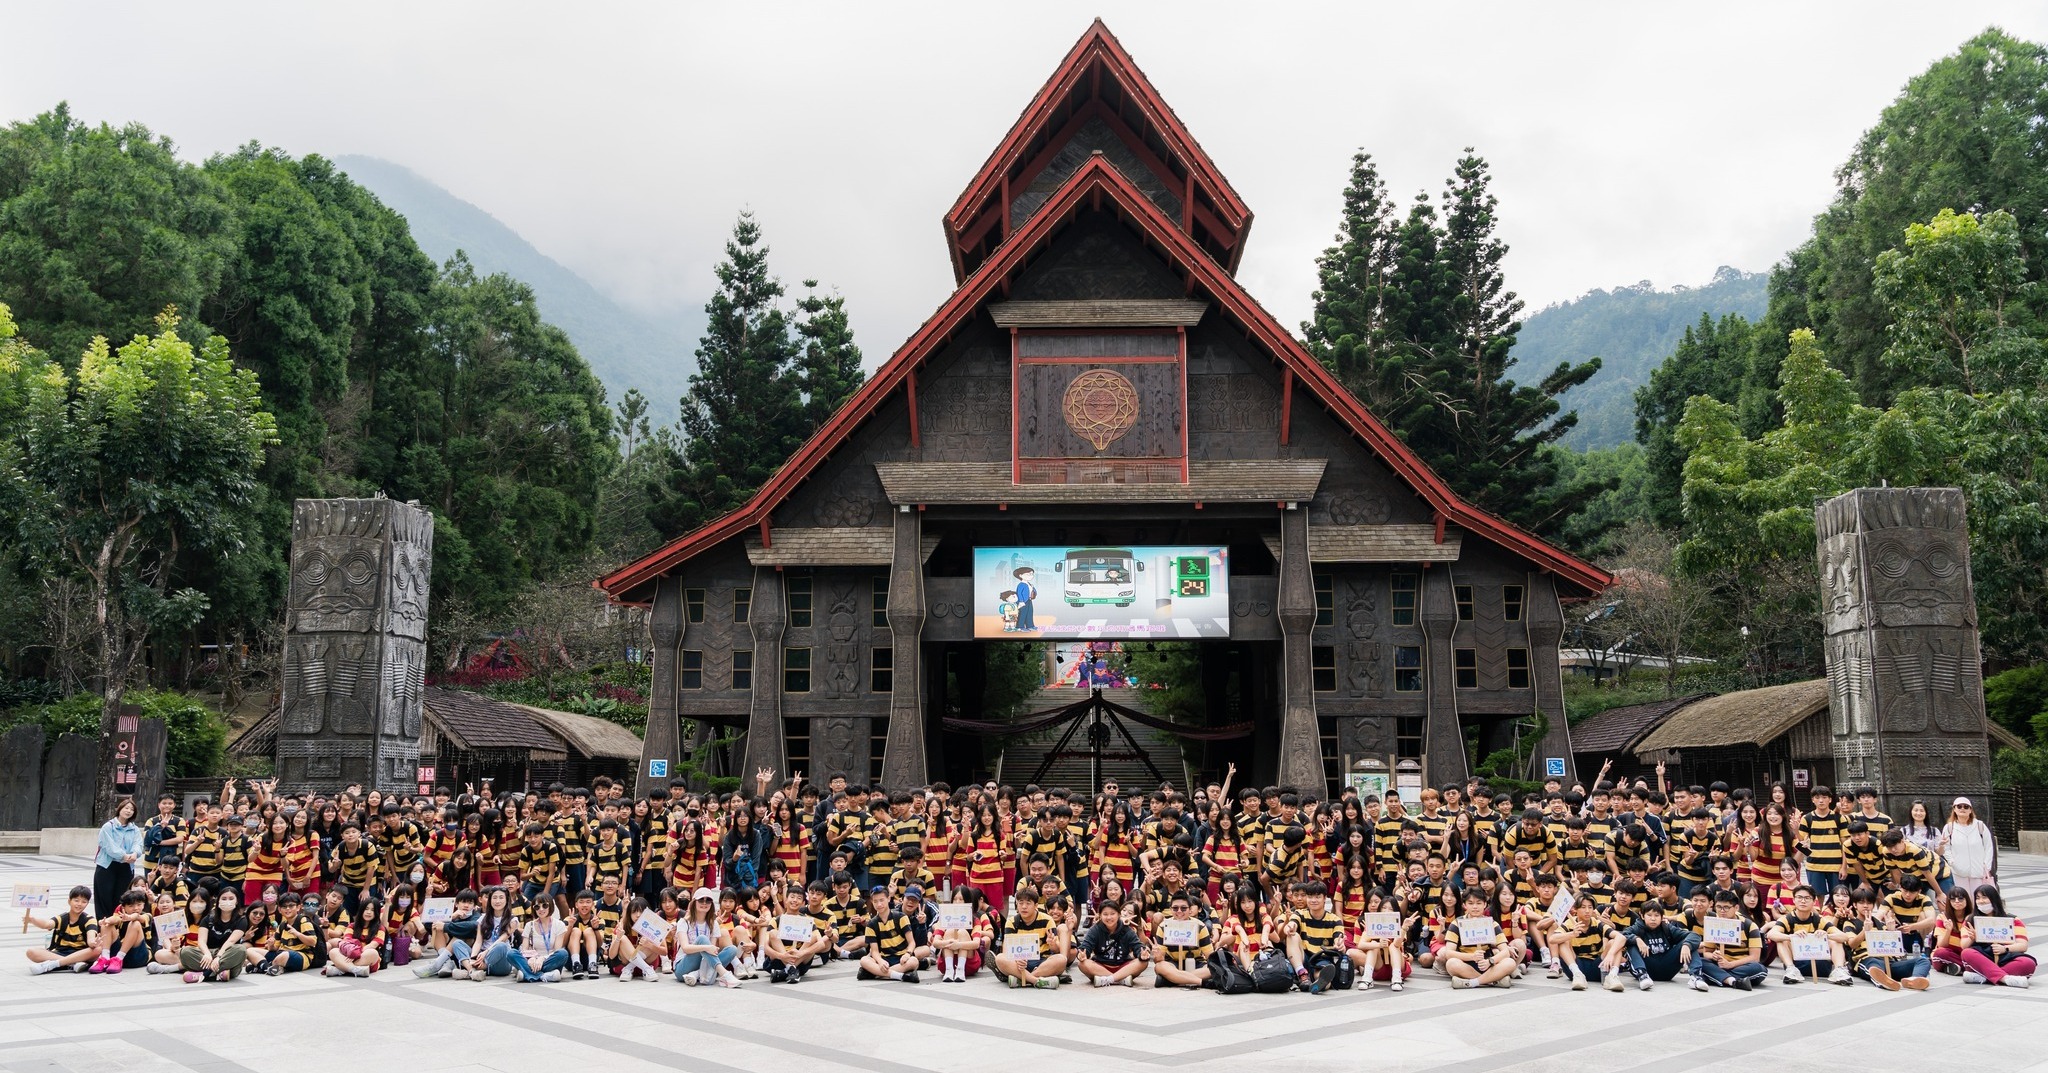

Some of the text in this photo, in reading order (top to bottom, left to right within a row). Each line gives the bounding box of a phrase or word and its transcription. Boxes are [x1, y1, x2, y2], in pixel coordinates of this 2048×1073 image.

[1182, 580, 1204, 594] 24
[162, 921, 182, 931] 7-2
[642, 921, 662, 937] 8-2
[785, 925, 807, 935] 9-1
[1465, 929, 1489, 937] 11-1
[1710, 929, 1735, 937] 11-3
